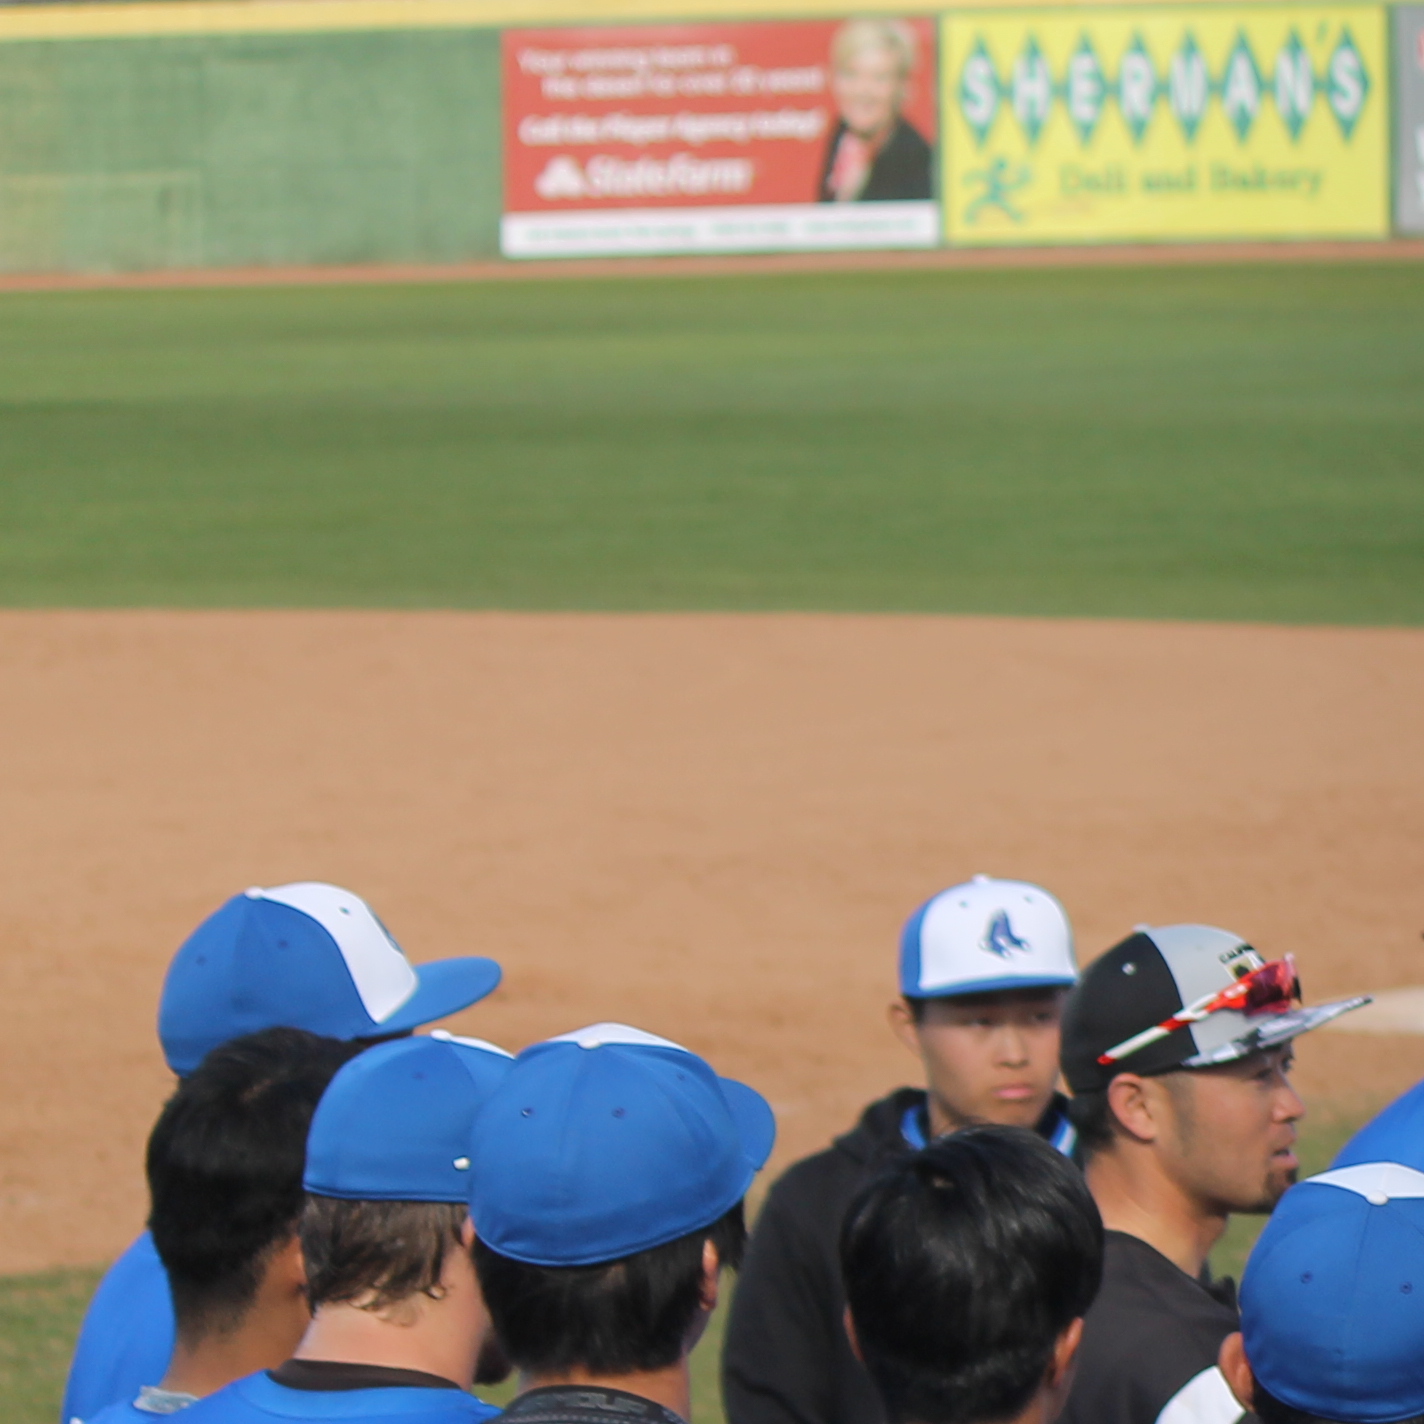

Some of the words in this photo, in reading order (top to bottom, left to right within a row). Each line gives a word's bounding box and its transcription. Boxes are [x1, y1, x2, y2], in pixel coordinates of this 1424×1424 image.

[958, 24, 1370, 132] SHERMAN'S
[1141, 164, 1199, 193] and
[1209, 162, 1325, 198] Bakery
